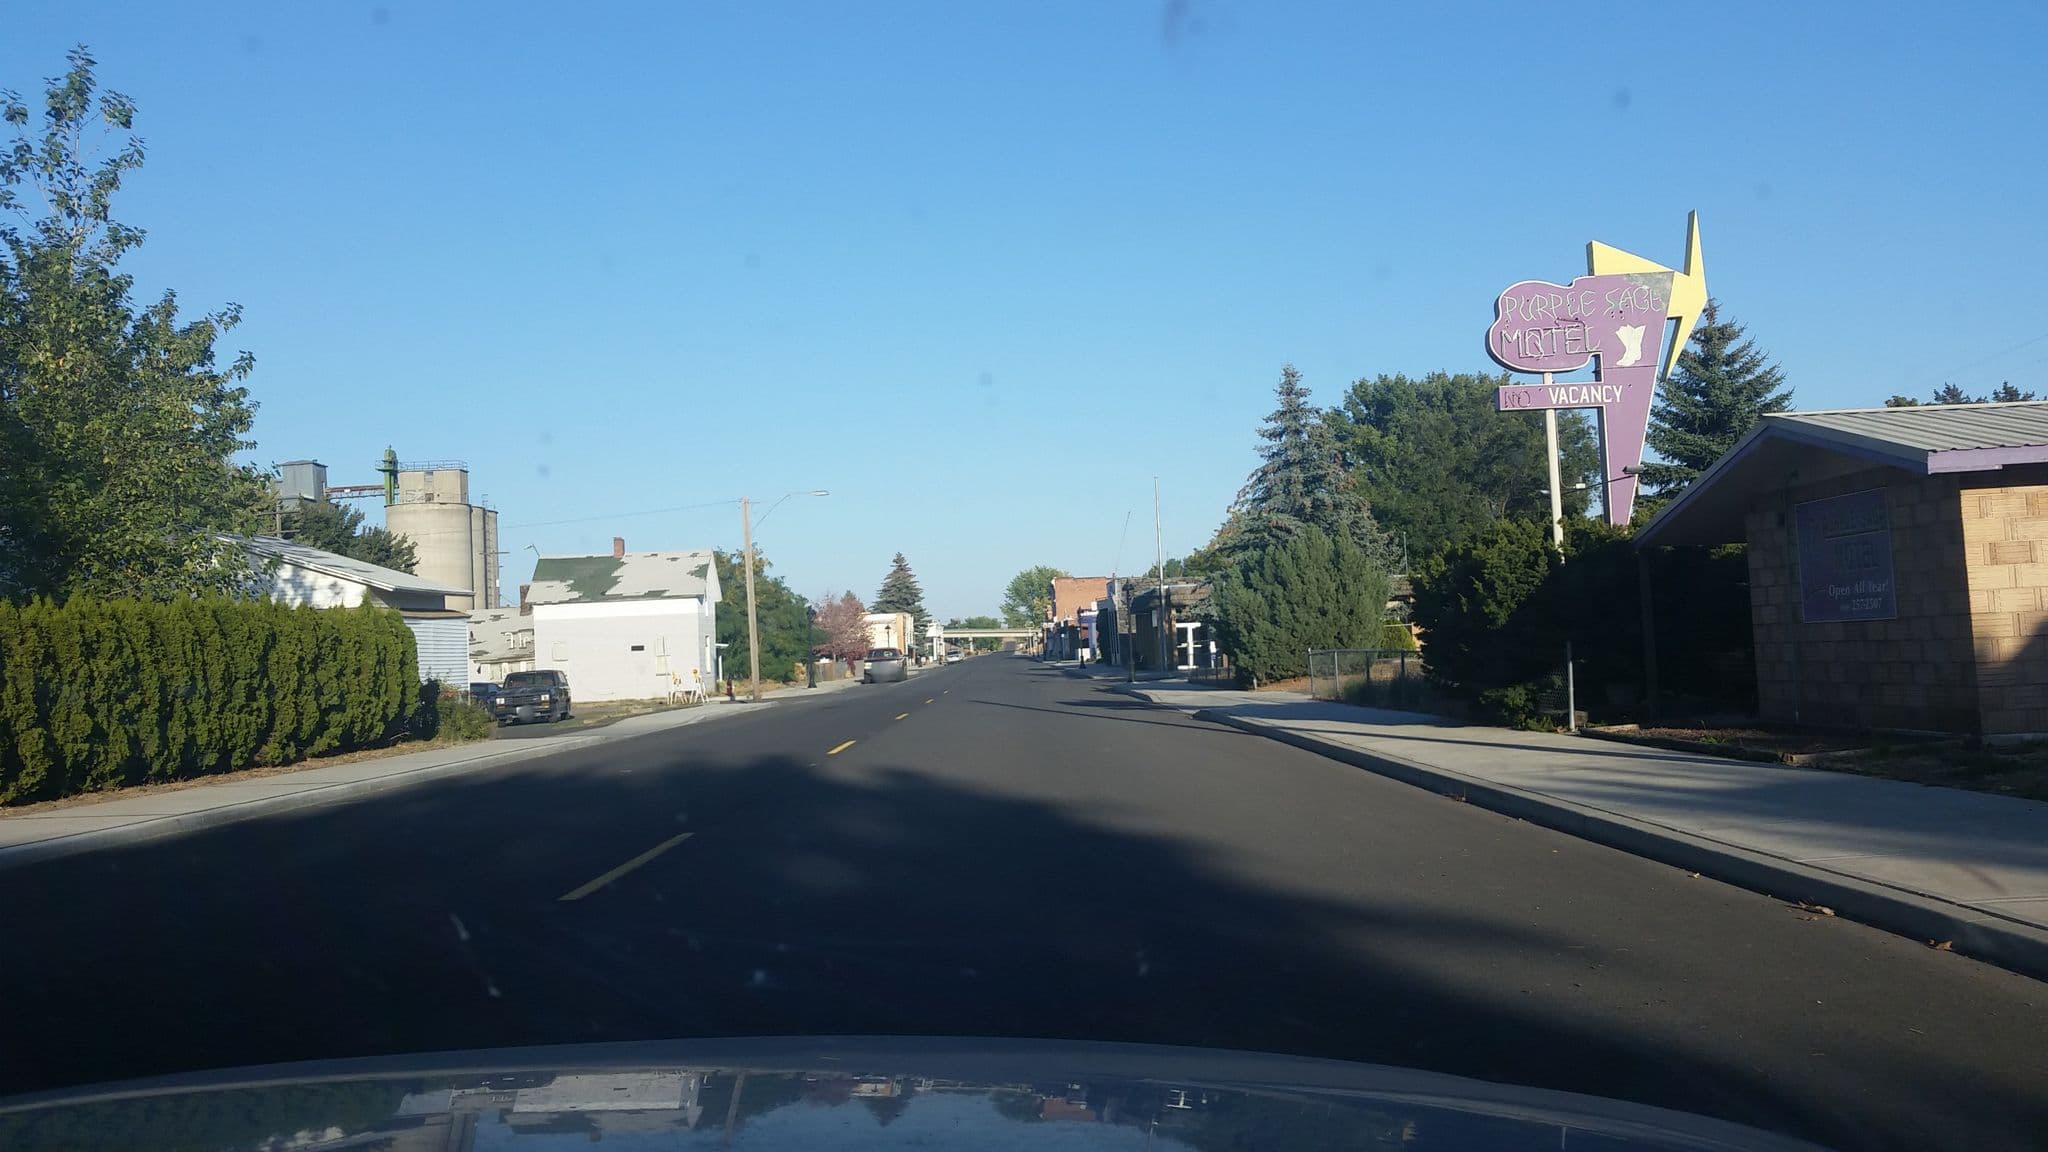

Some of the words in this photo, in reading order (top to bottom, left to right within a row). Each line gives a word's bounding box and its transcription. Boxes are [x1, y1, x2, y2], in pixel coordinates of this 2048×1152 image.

[1503, 290, 1597, 321] PURPLE
[1604, 287, 1663, 314] SAGE
[1501, 326, 1601, 359] MOTEL
[1504, 390, 1532, 408] NO
[1548, 385, 1623, 405] VACANCY
[1828, 584, 1850, 600] Open
[1855, 580, 1865, 593] All
